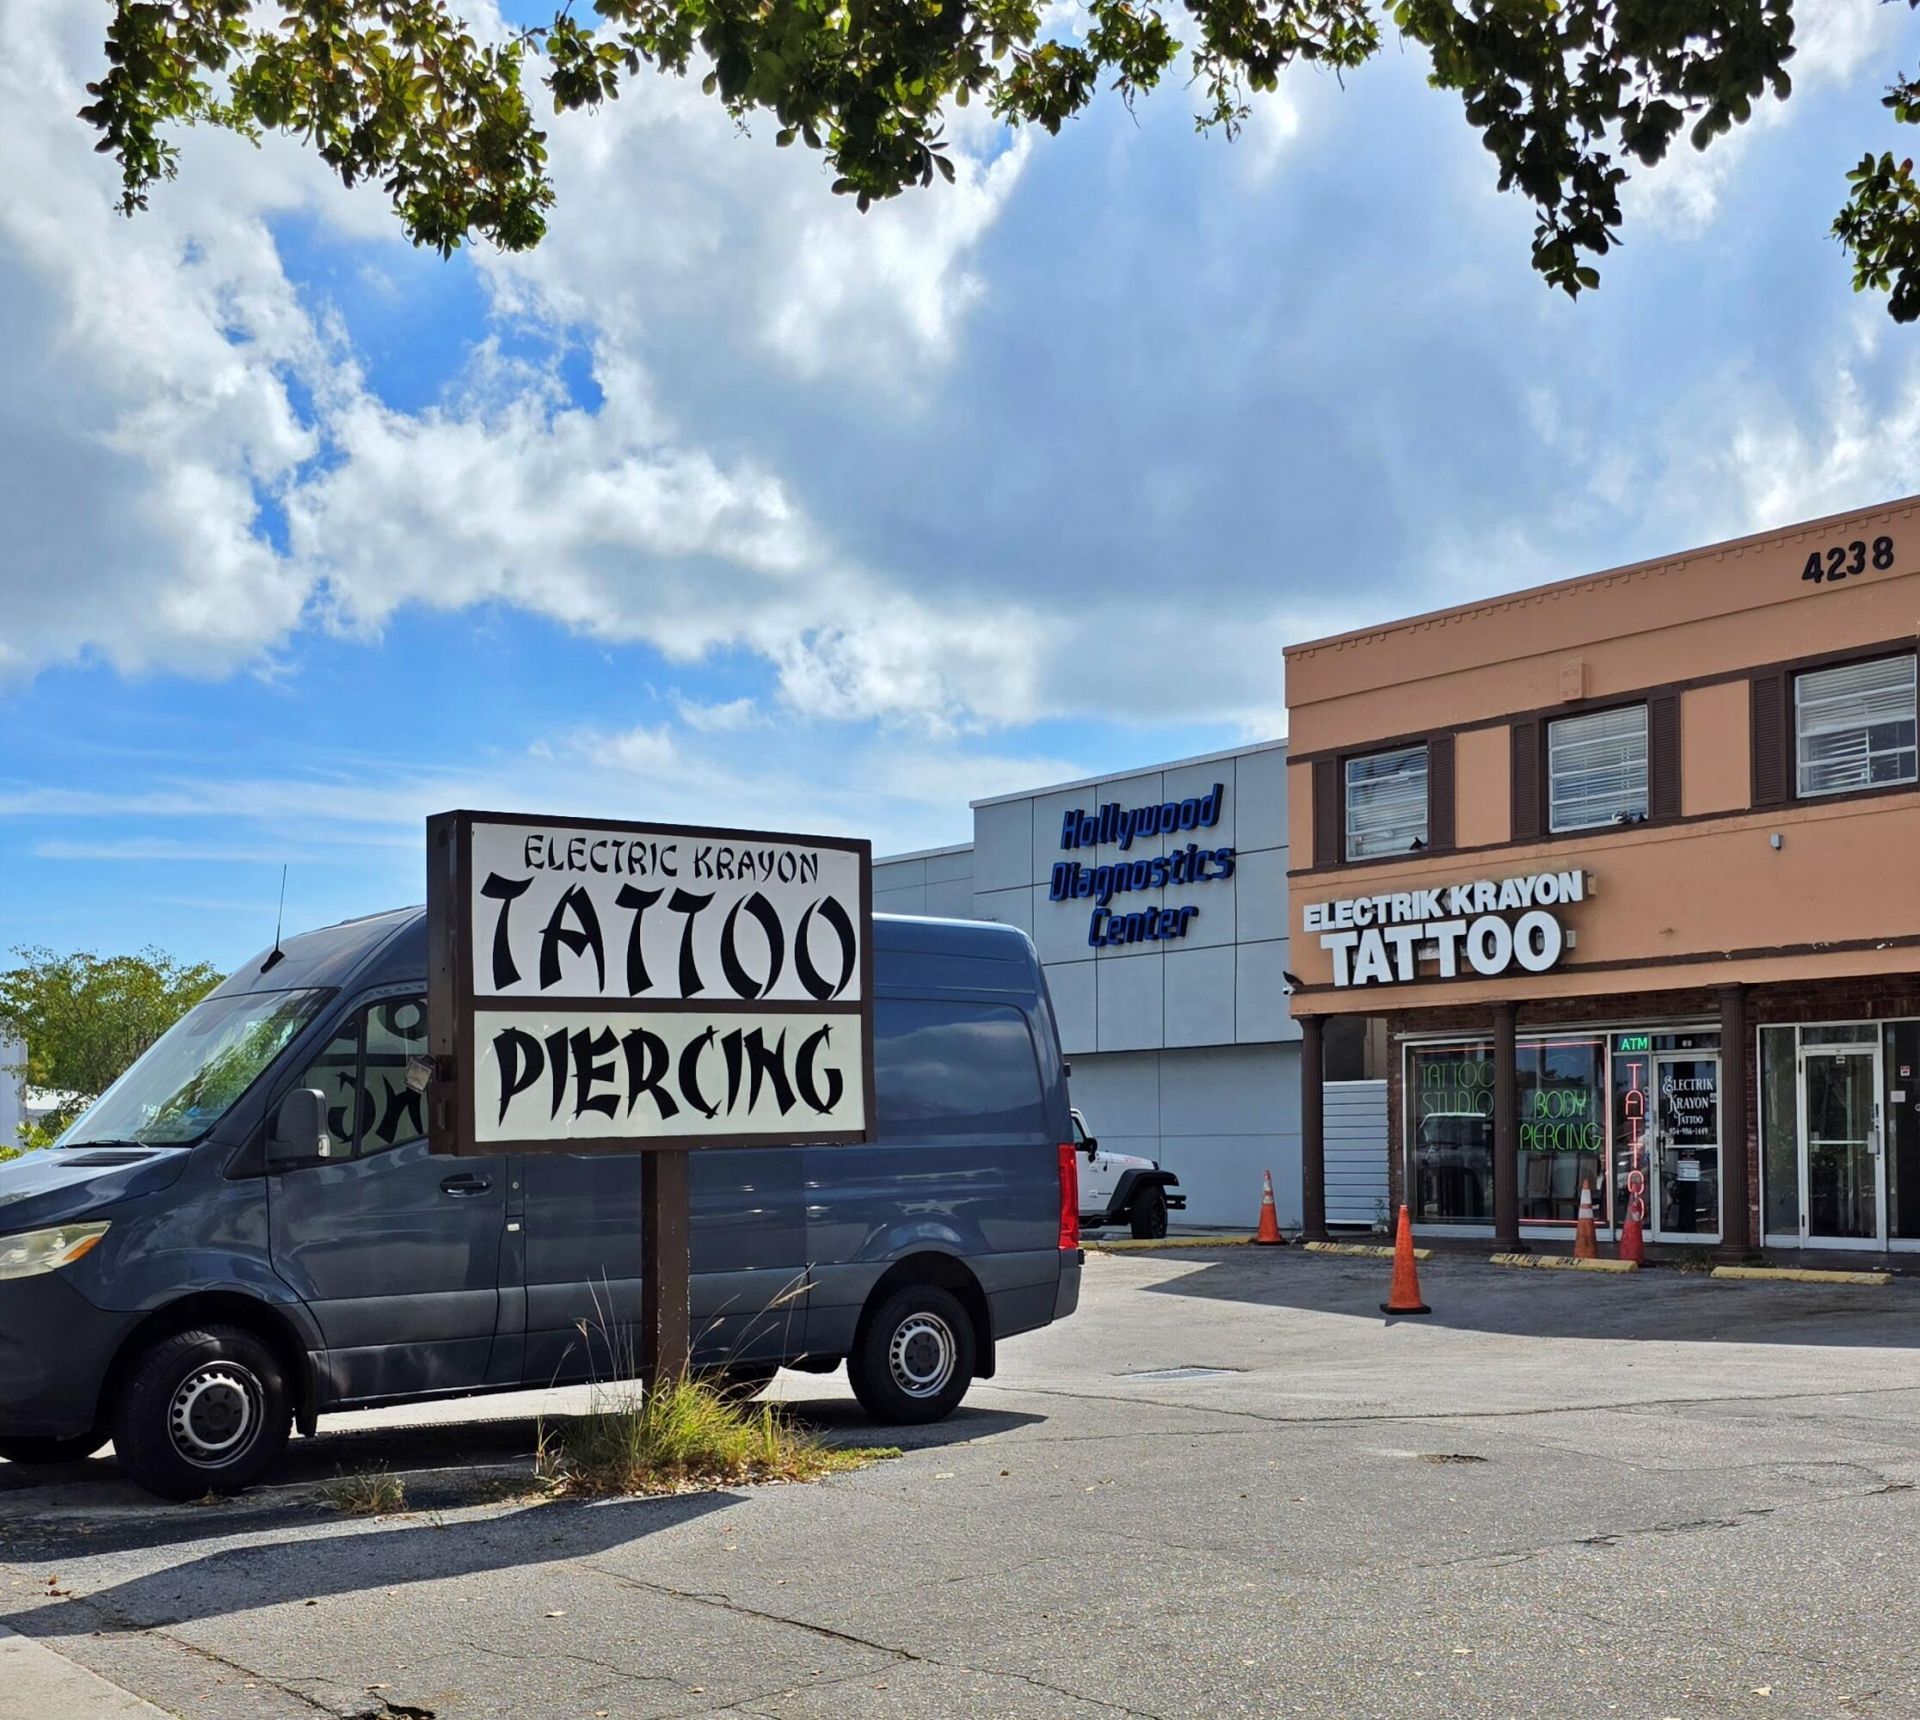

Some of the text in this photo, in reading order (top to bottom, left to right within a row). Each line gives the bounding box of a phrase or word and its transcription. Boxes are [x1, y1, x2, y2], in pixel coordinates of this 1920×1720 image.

[1801, 536, 1894, 583] 4238
[1060, 783, 1224, 850] Hollywood
[524, 834, 819, 885] ELECTRIC KRAYON
[1049, 843, 1236, 906] Diagnostics
[1303, 870, 1585, 932] ELECTRIK KRAYON
[480, 871, 856, 1001] TATTOO
[1088, 906, 1199, 947] Center
[1320, 910, 1563, 987] TATTOO
[1621, 1037, 1648, 1051] ATM
[492, 1023, 844, 1127] PIERCING
[1420, 1061, 1496, 1088] TATTOO
[1662, 1075, 1714, 1094] ELECTRIK
[1422, 1090, 1495, 1116] STUDIO
[1534, 1090, 1587, 1119] BODY
[1667, 1094, 1709, 1114] KRAYON
[1673, 1112, 1704, 1126] TATTOO
[1520, 1122, 1602, 1150] PIERCING
